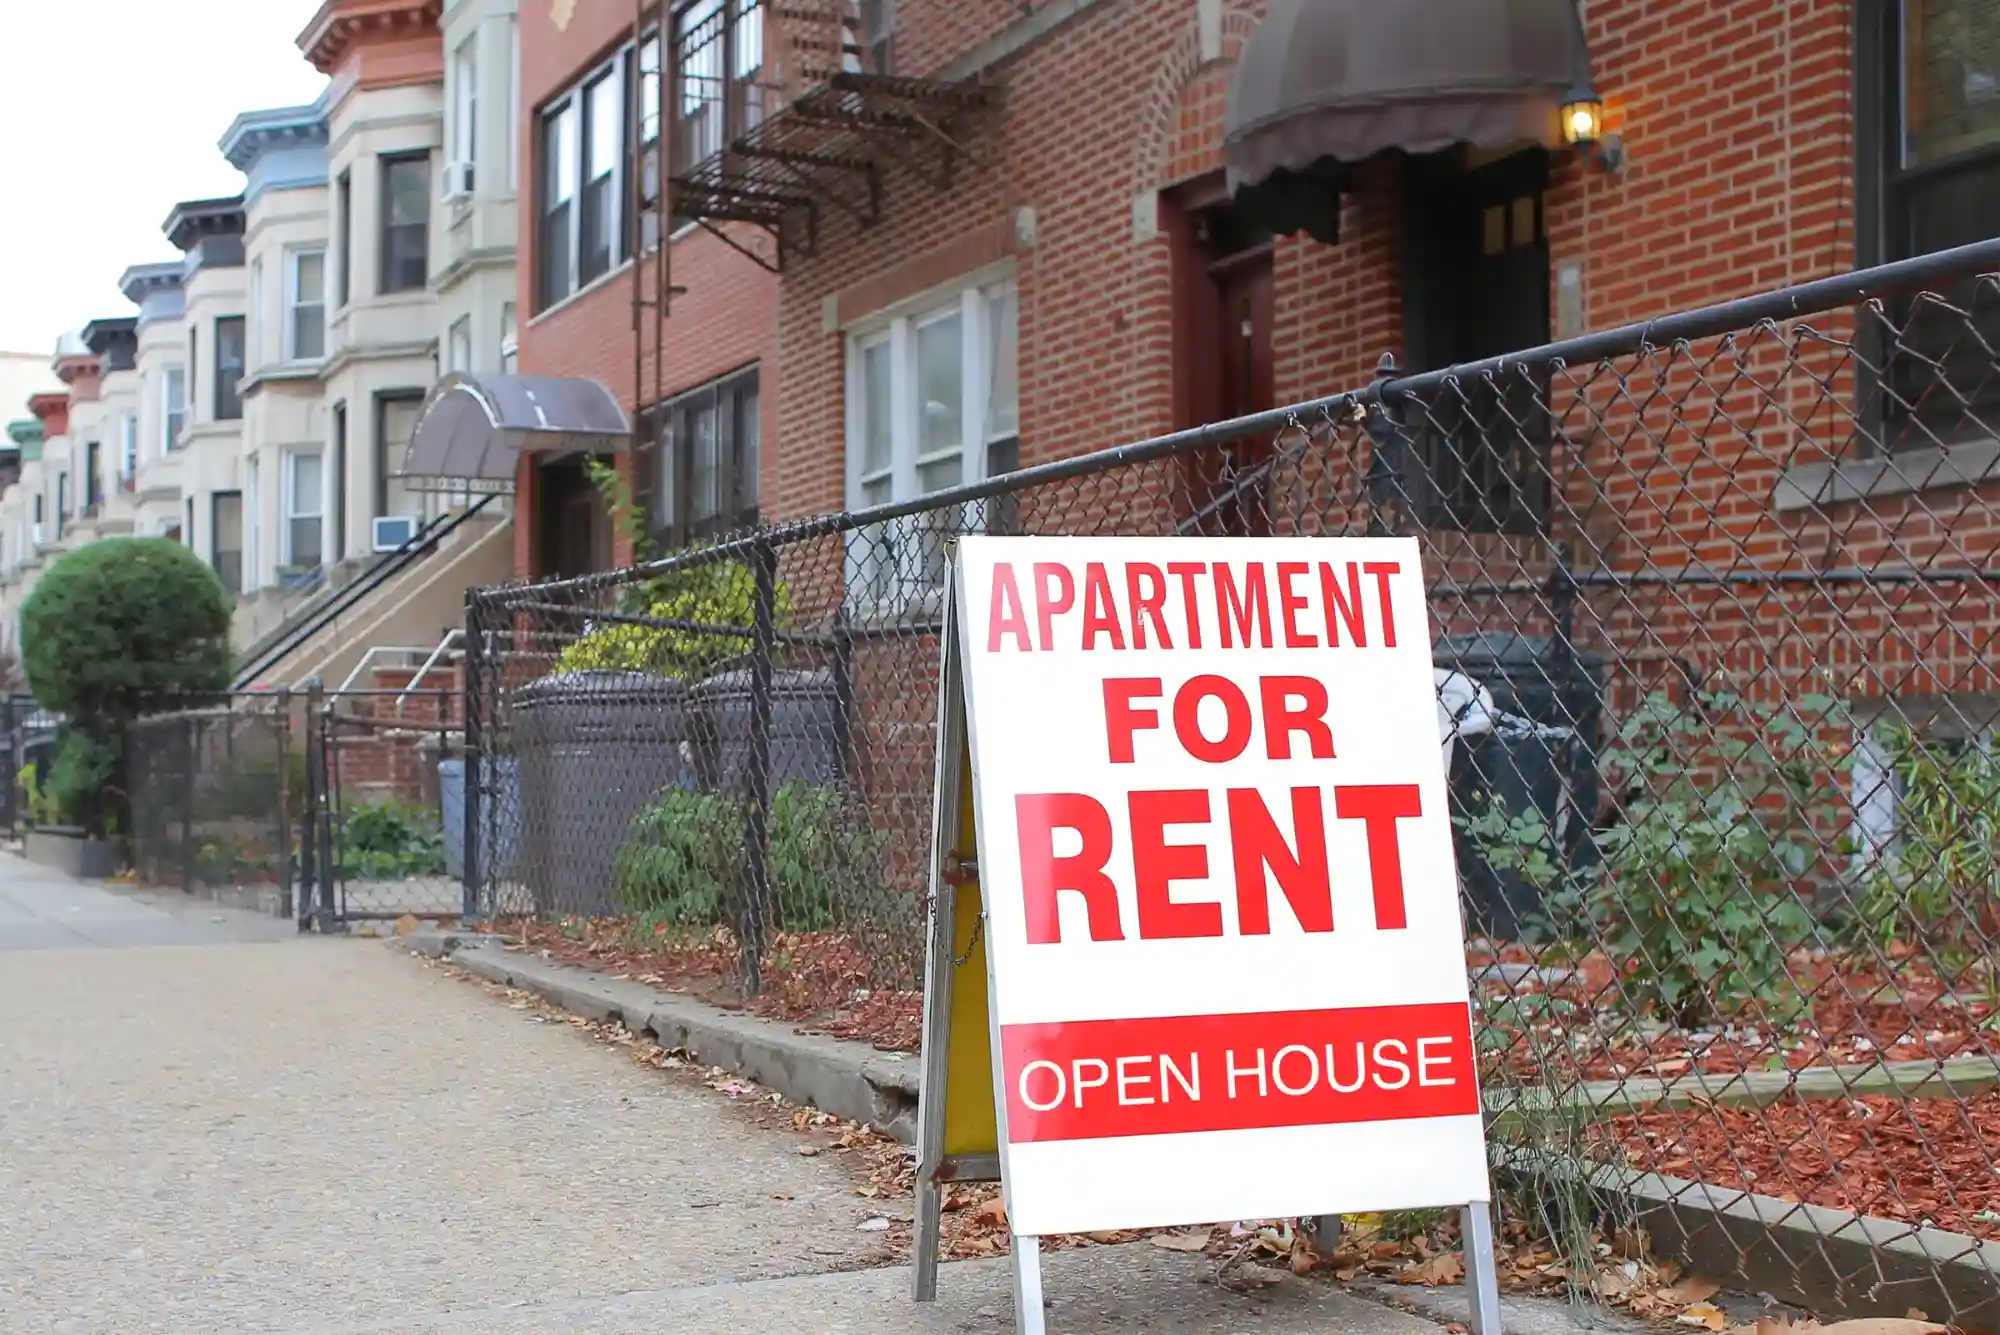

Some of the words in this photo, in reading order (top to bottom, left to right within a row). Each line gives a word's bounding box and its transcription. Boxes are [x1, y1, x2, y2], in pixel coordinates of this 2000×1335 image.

[988, 561, 1400, 652] APARTMENT
[1103, 674, 1337, 764] FOR
[1015, 784, 1422, 944] RENT
[1018, 1052, 1201, 1112] OPEN
[1226, 1036, 1456, 1099] HOUSE
